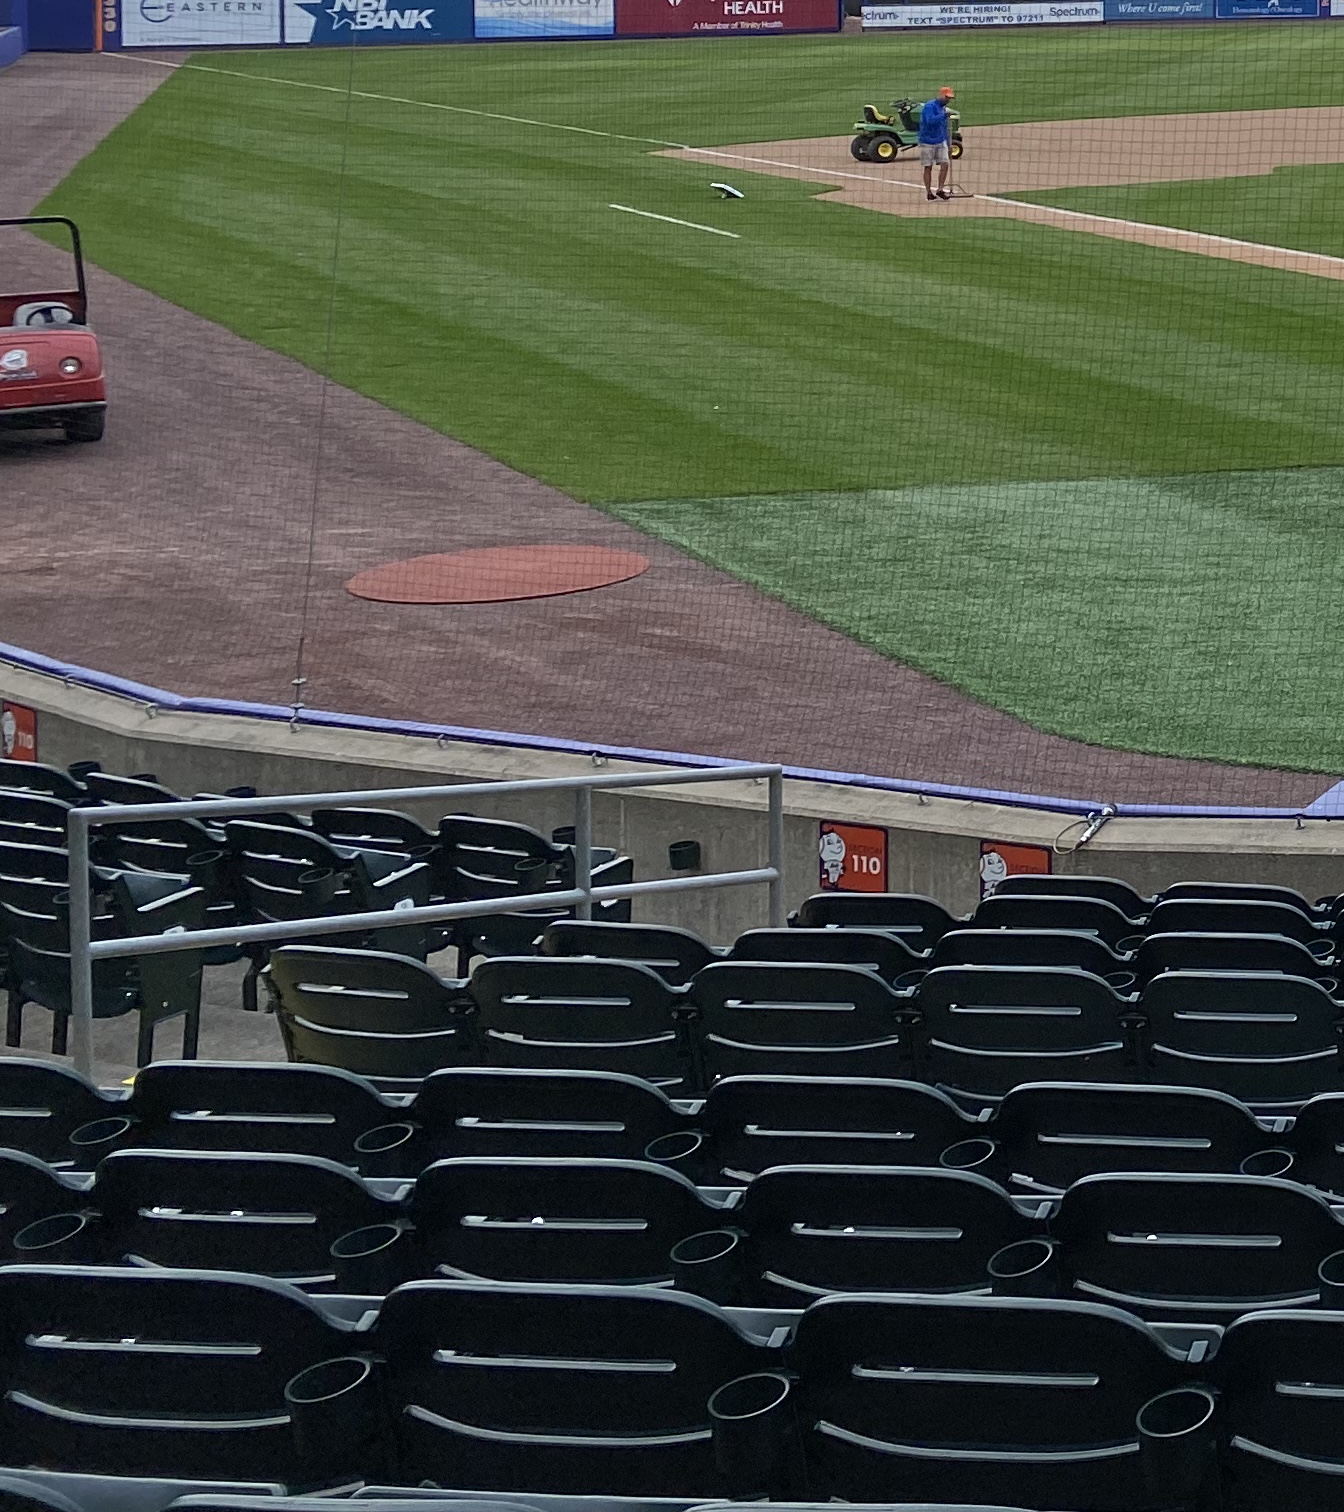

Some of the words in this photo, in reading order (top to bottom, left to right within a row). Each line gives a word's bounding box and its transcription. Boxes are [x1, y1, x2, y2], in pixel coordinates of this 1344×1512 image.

[166, 2, 263, 13] EASTERN
[724, 1, 783, 15] HEALTH
[973, 5, 1011, 14] HIRING!
[1050, 7, 1098, 18] Spectrum
[1118, 3, 1146, 13] Where
[1149, 2, 1157, 12] U
[1158, 4, 1180, 13] come
[353, 9, 435, 30] BANK
[862, 10, 896, 21] ctrum
[908, 17, 933, 25] TEXT
[852, 854, 881, 875] 110
